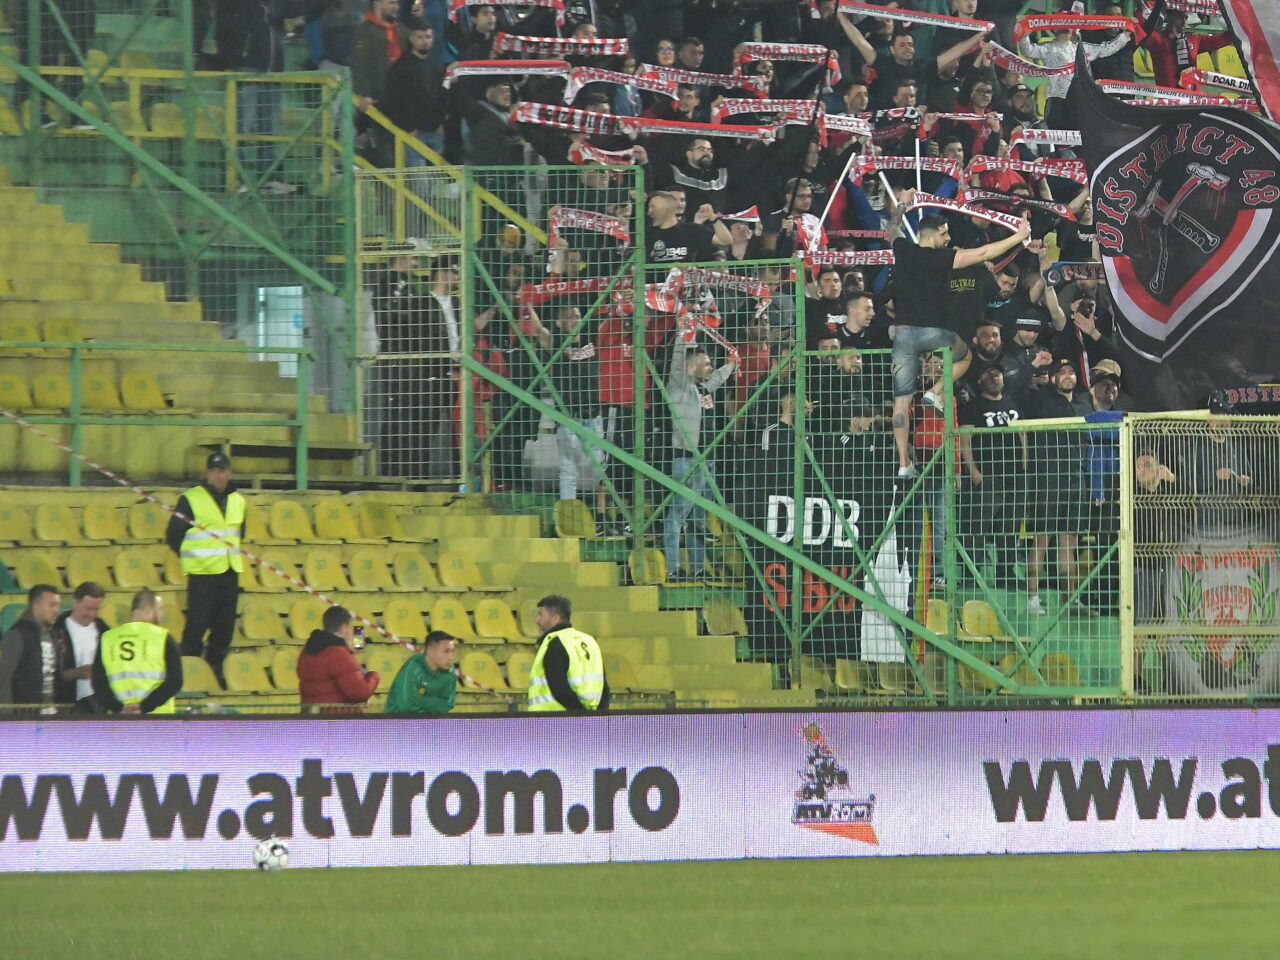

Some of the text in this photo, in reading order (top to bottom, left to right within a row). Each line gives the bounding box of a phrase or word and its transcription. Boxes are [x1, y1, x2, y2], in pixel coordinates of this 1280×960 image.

[1212, 75, 1236, 88] DOAR
[1096, 123, 1280, 251] DISTRICT 48
[812, 256, 895, 265] BUCUREST
[119, 641, 135, 662] S
